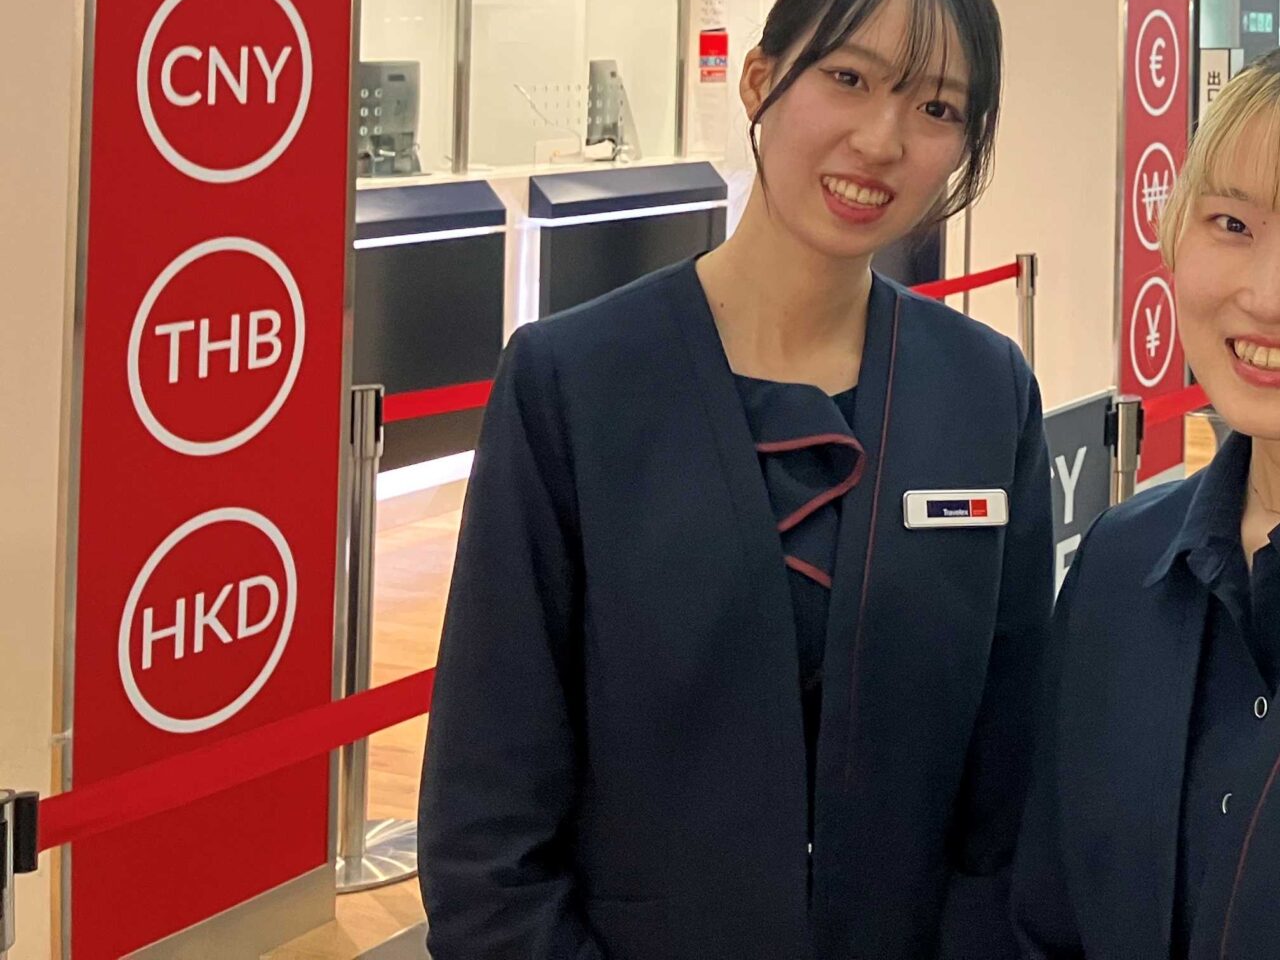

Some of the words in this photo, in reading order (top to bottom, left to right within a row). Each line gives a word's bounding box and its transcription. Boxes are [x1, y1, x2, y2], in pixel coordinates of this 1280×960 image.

[160, 45, 292, 107] CNY
[1149, 37, 1166, 88] €
[154, 308, 283, 384] THB
[1145, 304, 1161, 358] ¥
[141, 575, 279, 670] HKD
